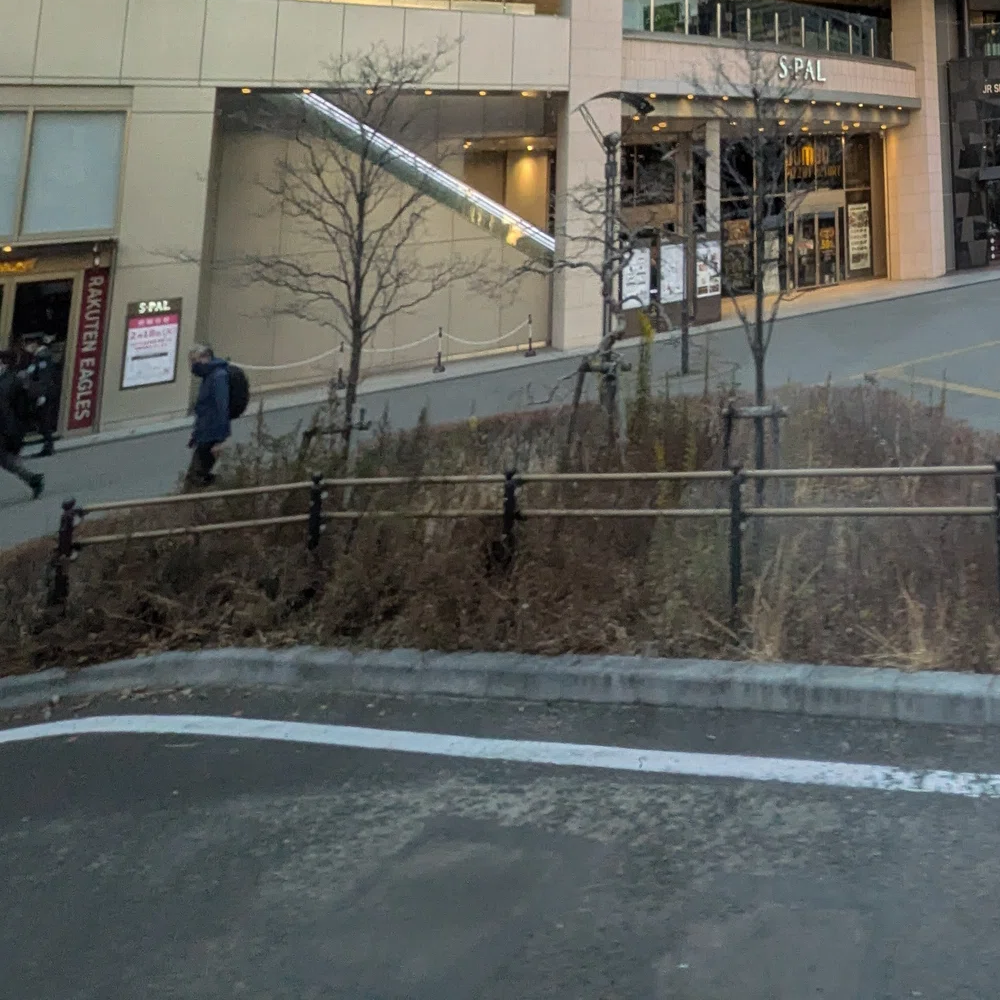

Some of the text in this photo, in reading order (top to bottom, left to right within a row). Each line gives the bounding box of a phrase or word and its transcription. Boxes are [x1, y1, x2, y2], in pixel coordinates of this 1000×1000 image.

[982, 84, 993, 94] JR
[74, 275, 105, 421] RAKUTEN EAGLES
